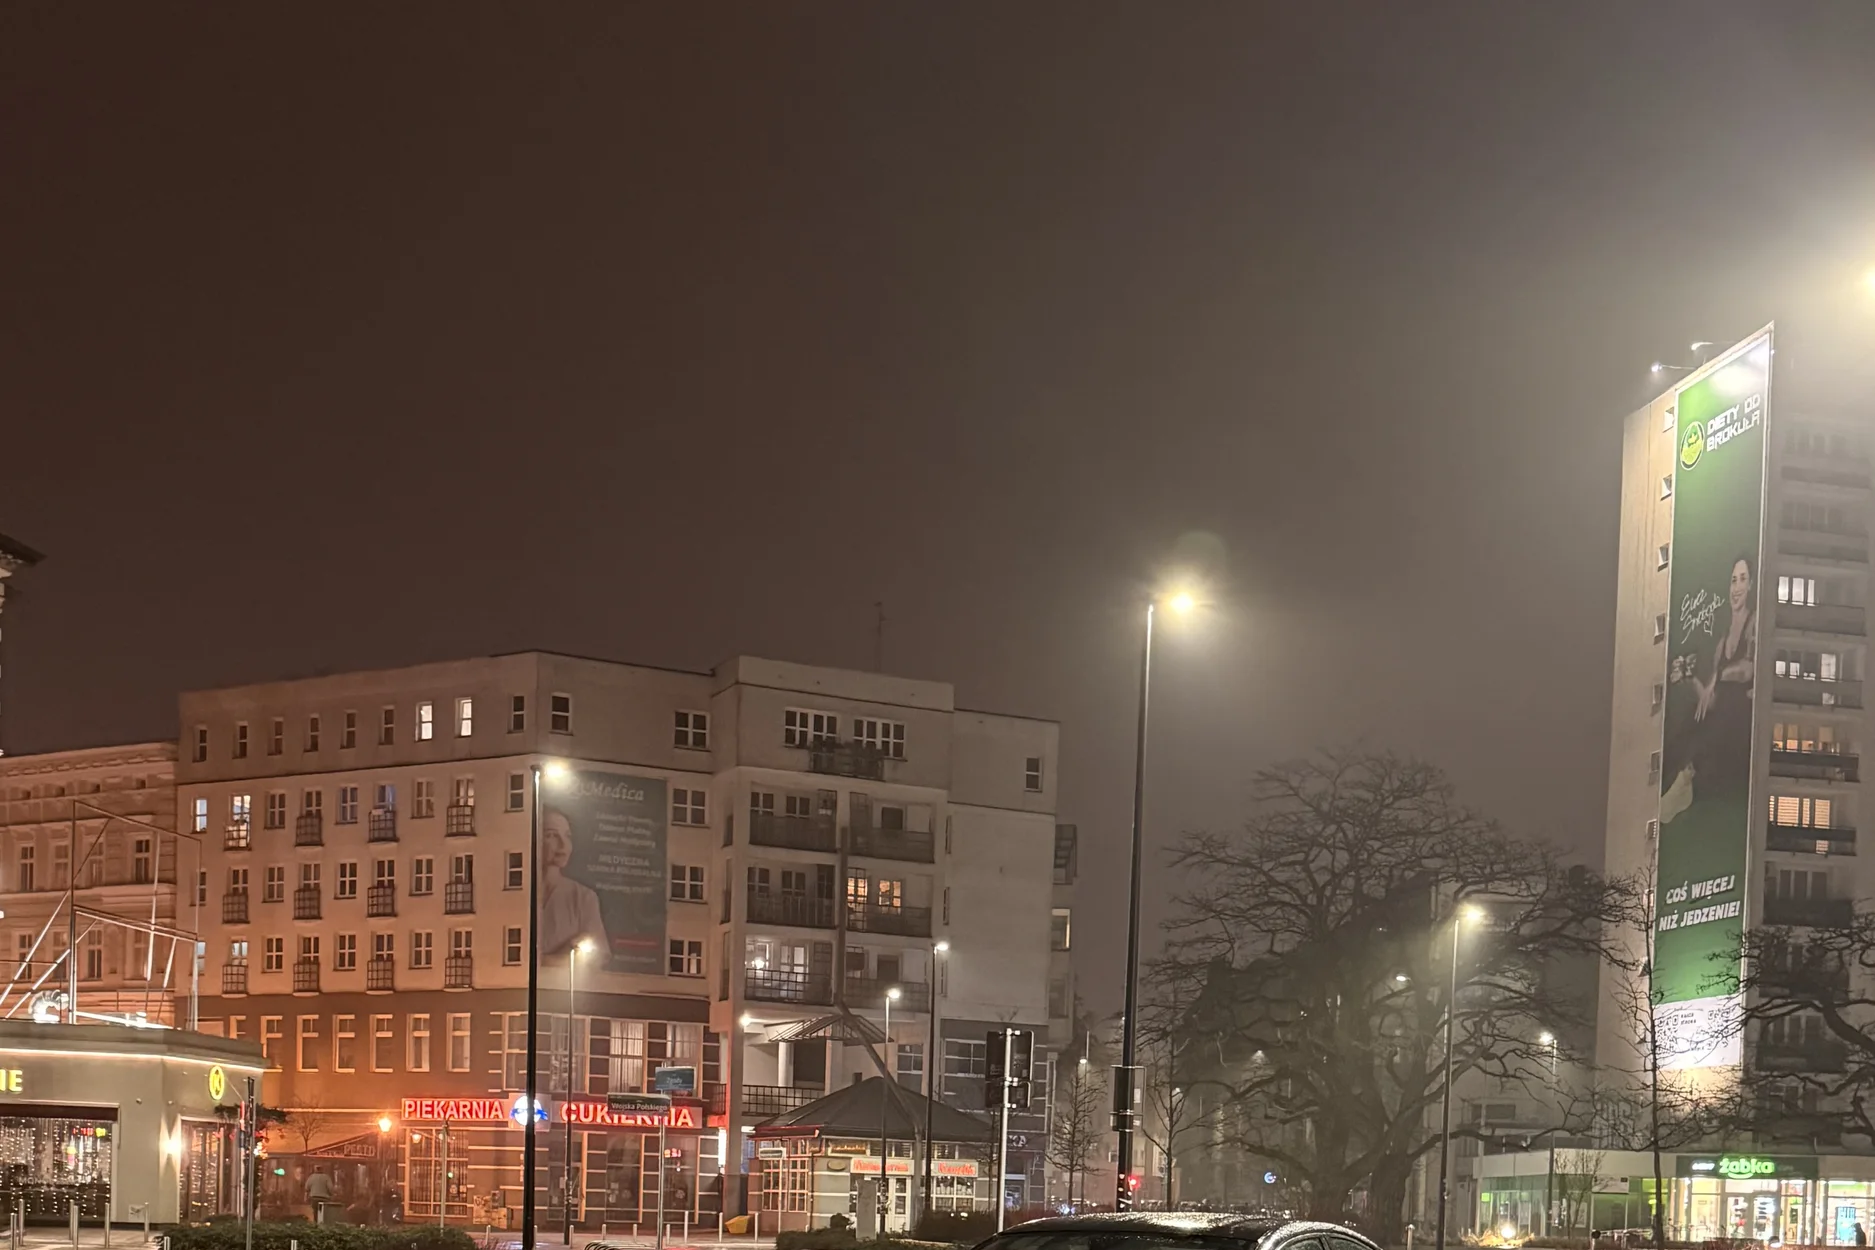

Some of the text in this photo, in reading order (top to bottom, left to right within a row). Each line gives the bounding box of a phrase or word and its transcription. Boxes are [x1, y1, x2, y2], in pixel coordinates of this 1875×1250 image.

[1706, 393, 1761, 436] DIETY OD
[1665, 874, 1735, 904] COŚ WIĘCEJ
[1658, 900, 1741, 932] NIŻ JEDZENIE!
[404, 1100, 504, 1119] PIEKARNIA
[611, 1102, 668, 1112] Wojska Polskiego
[1719, 1158, 1775, 1175] żabka
